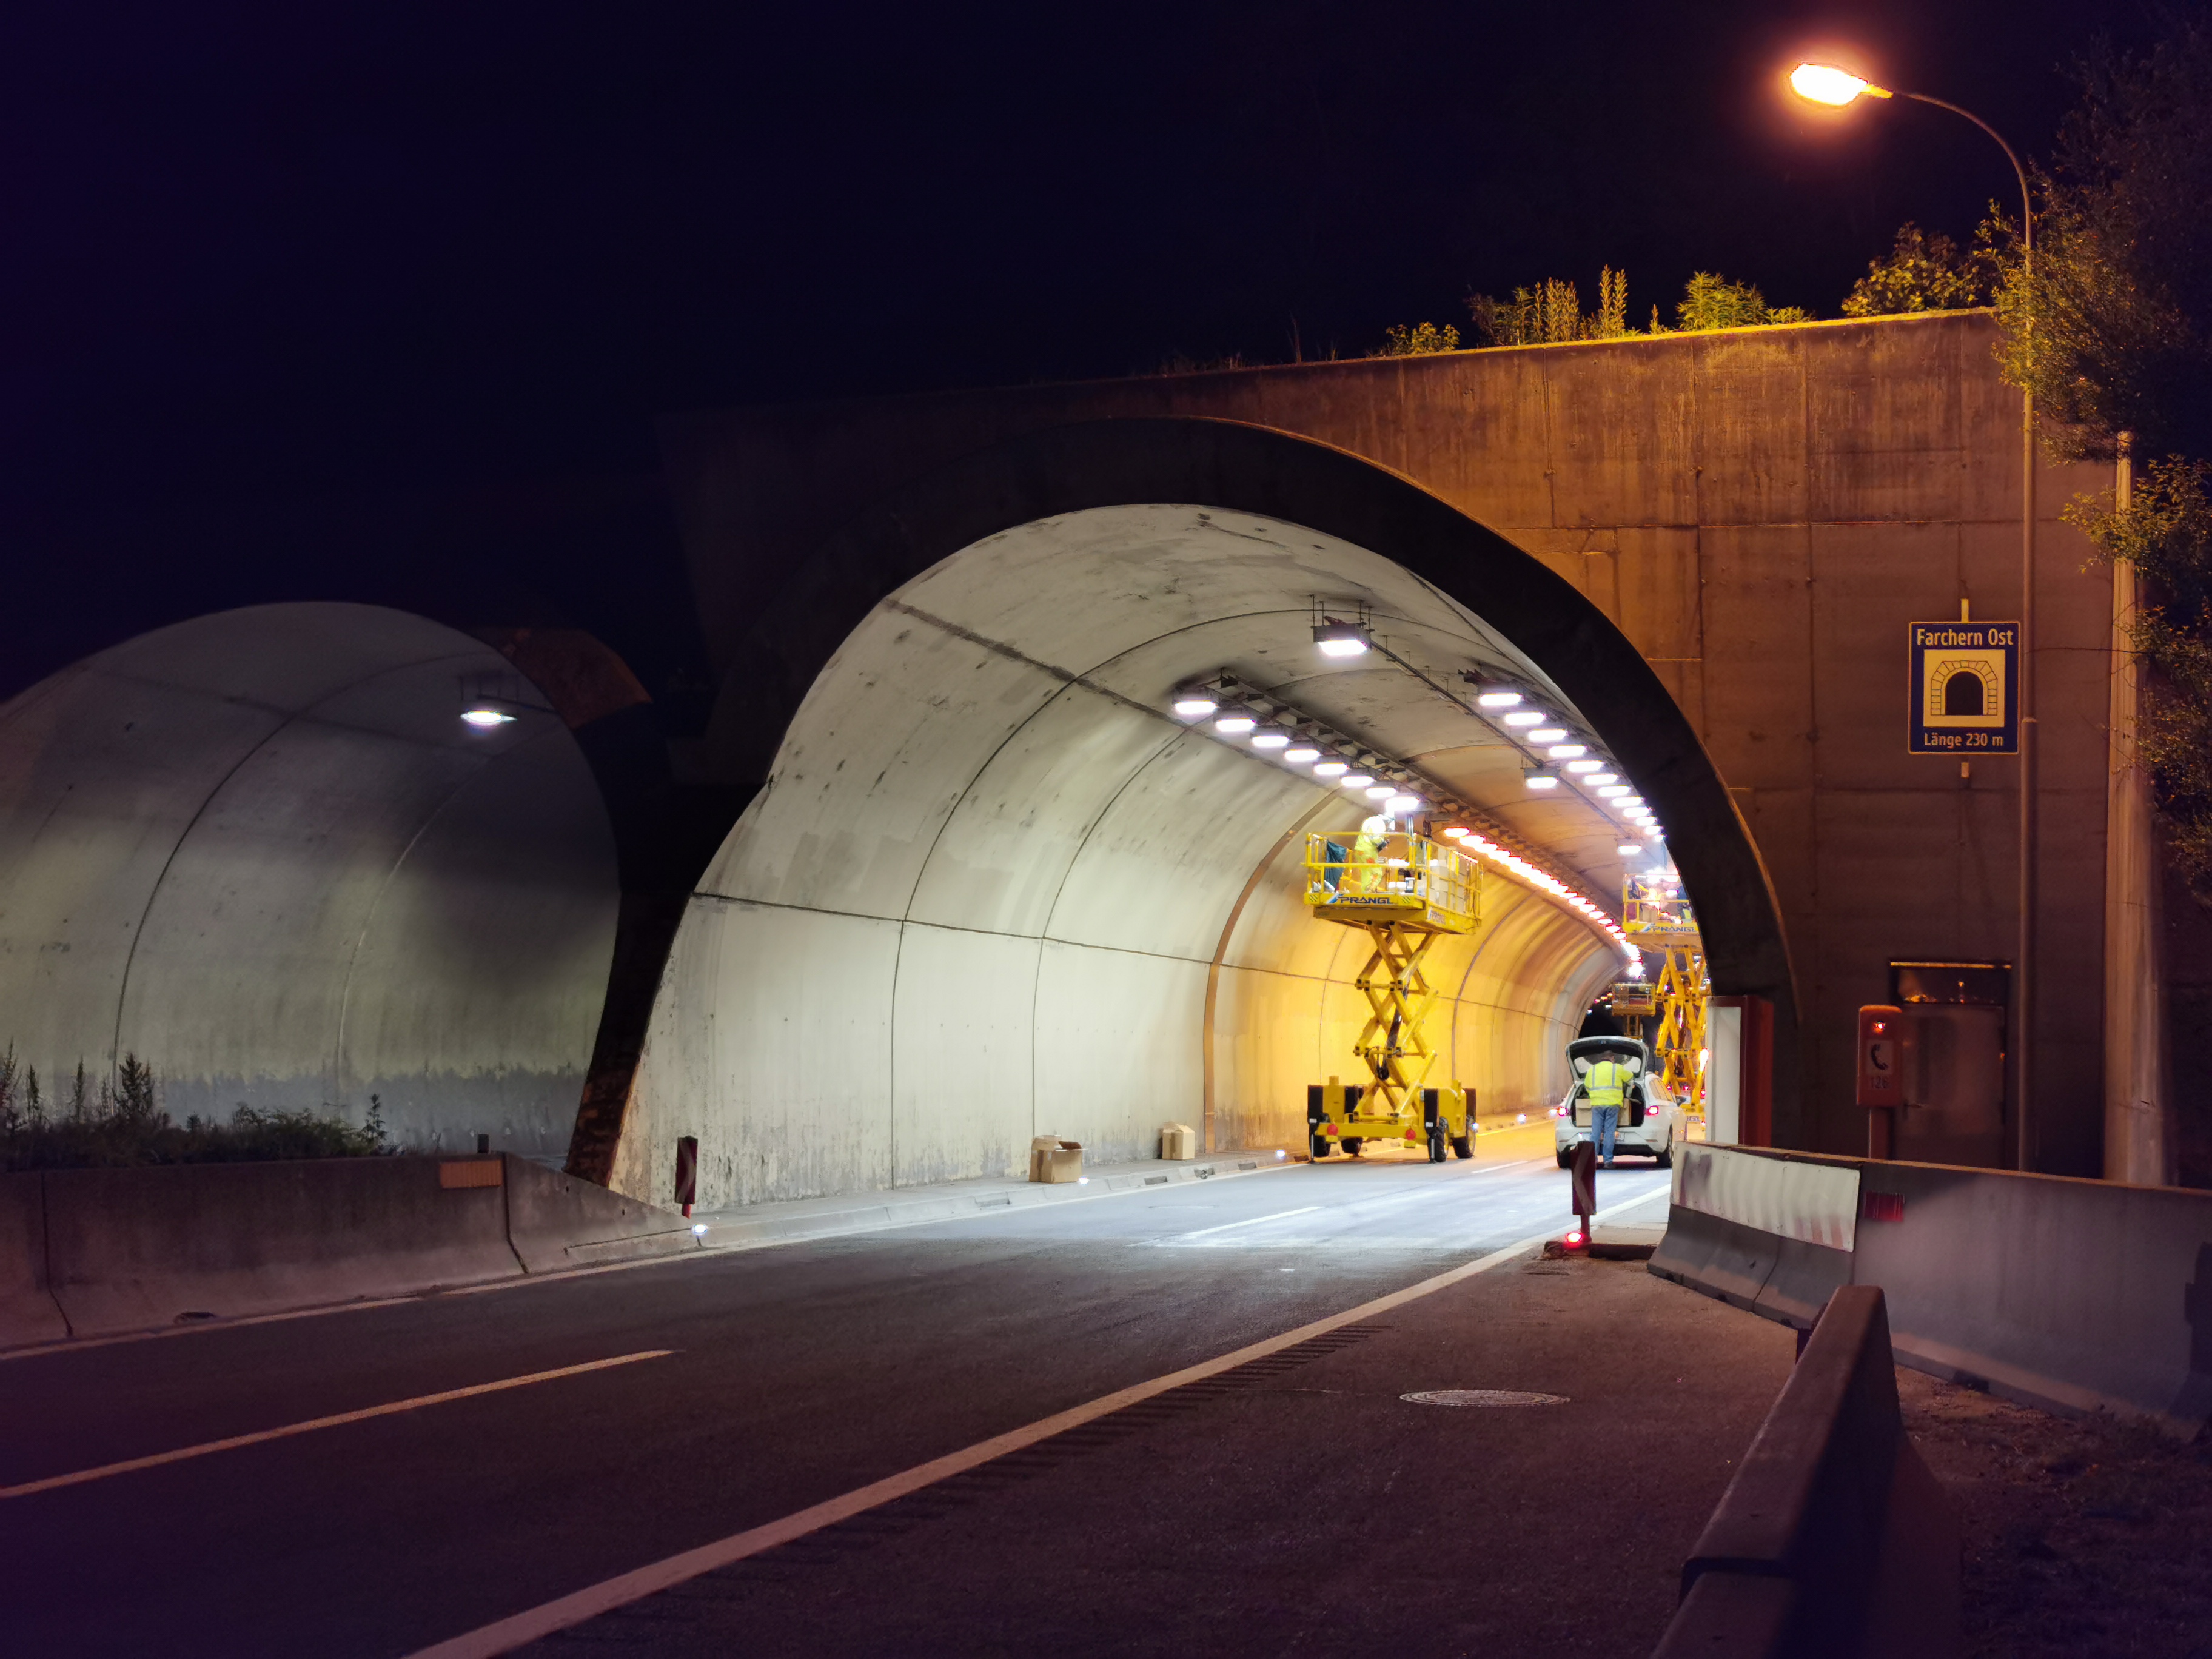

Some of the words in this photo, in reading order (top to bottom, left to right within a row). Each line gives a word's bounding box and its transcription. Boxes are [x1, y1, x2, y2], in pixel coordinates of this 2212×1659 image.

[1917, 628, 1983, 646] Farchern
[1988, 628, 2014, 646] Ost
[1925, 732, 1962, 749] Länge
[1966, 734, 1988, 746] 230
[1992, 736, 2003, 746] m
[1337, 896, 1392, 904] PRANGL
